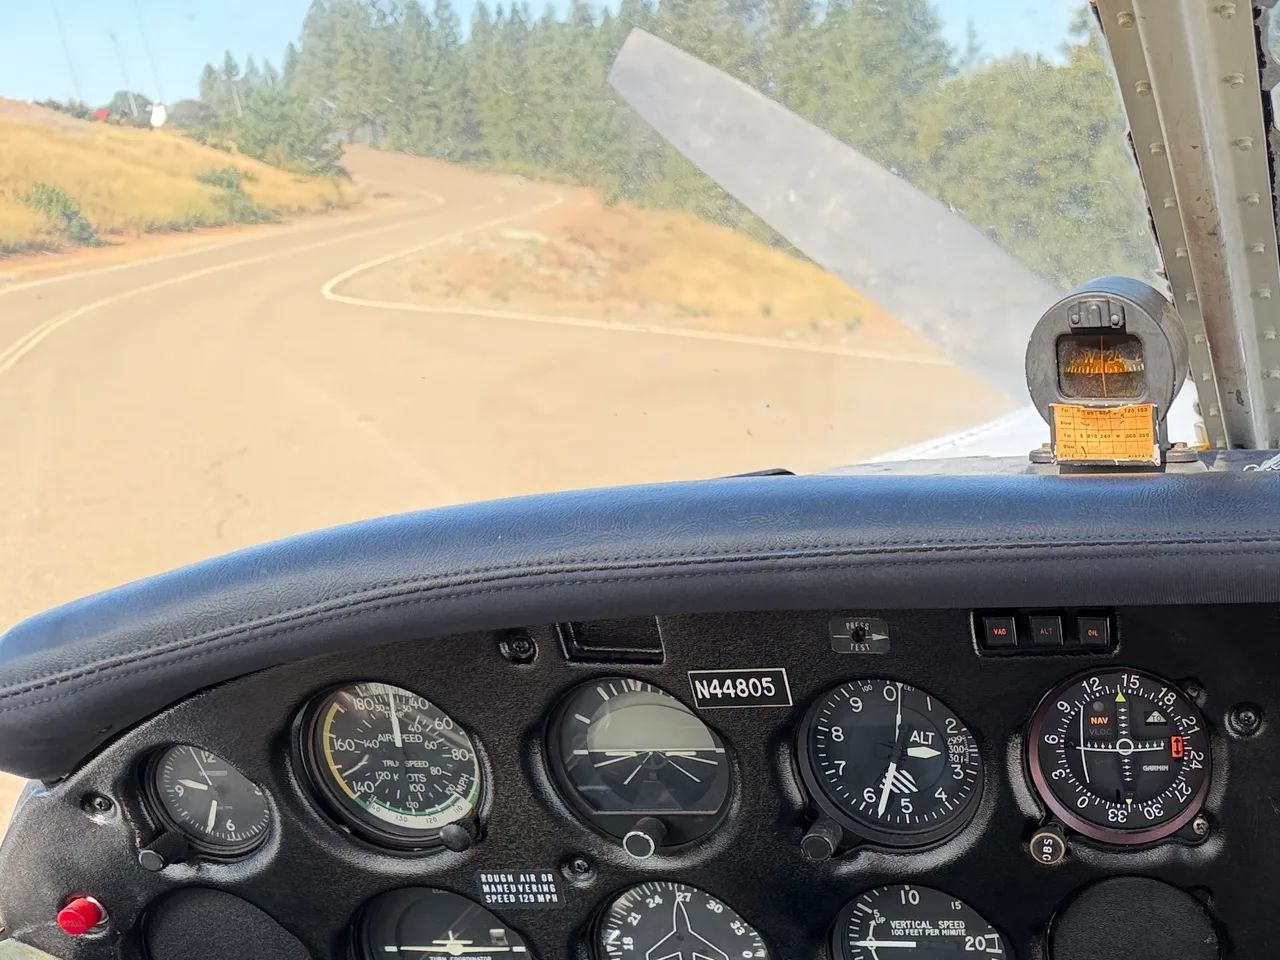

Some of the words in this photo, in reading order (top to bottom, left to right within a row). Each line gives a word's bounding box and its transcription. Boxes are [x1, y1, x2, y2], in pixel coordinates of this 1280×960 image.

[846, 622, 869, 631] PRESS
[850, 643, 870, 651] TEST
[1082, 677, 1102, 694] 12
[1122, 674, 1140, 689] 15
[694, 677, 775, 700] N44805
[1090, 716, 1109, 725] NAV
[910, 730, 935, 745] ALT
[334, 739, 355, 751] 160
[451, 749, 469, 761] 80
[1190, 751, 1204, 770] 24
[456, 773, 470, 794] MPH
[1042, 838, 1052, 861] OBS
[480, 874, 514, 883] ROUGH
[520, 874, 536, 882] AIR
[542, 873, 554, 882] OR
[482, 884, 557, 893] MANEUVERING
[486, 894, 516, 903] SPEED
[520, 894, 534, 903] 129
[538, 894, 558, 903] MPH
[646, 894, 663, 908] 24
[706, 900, 723, 913] 30
[730, 920, 746, 936] 33
[890, 920, 932, 929] VERTICAL
[938, 920, 966, 929] SPEED
[965, 936, 986, 951] 20
